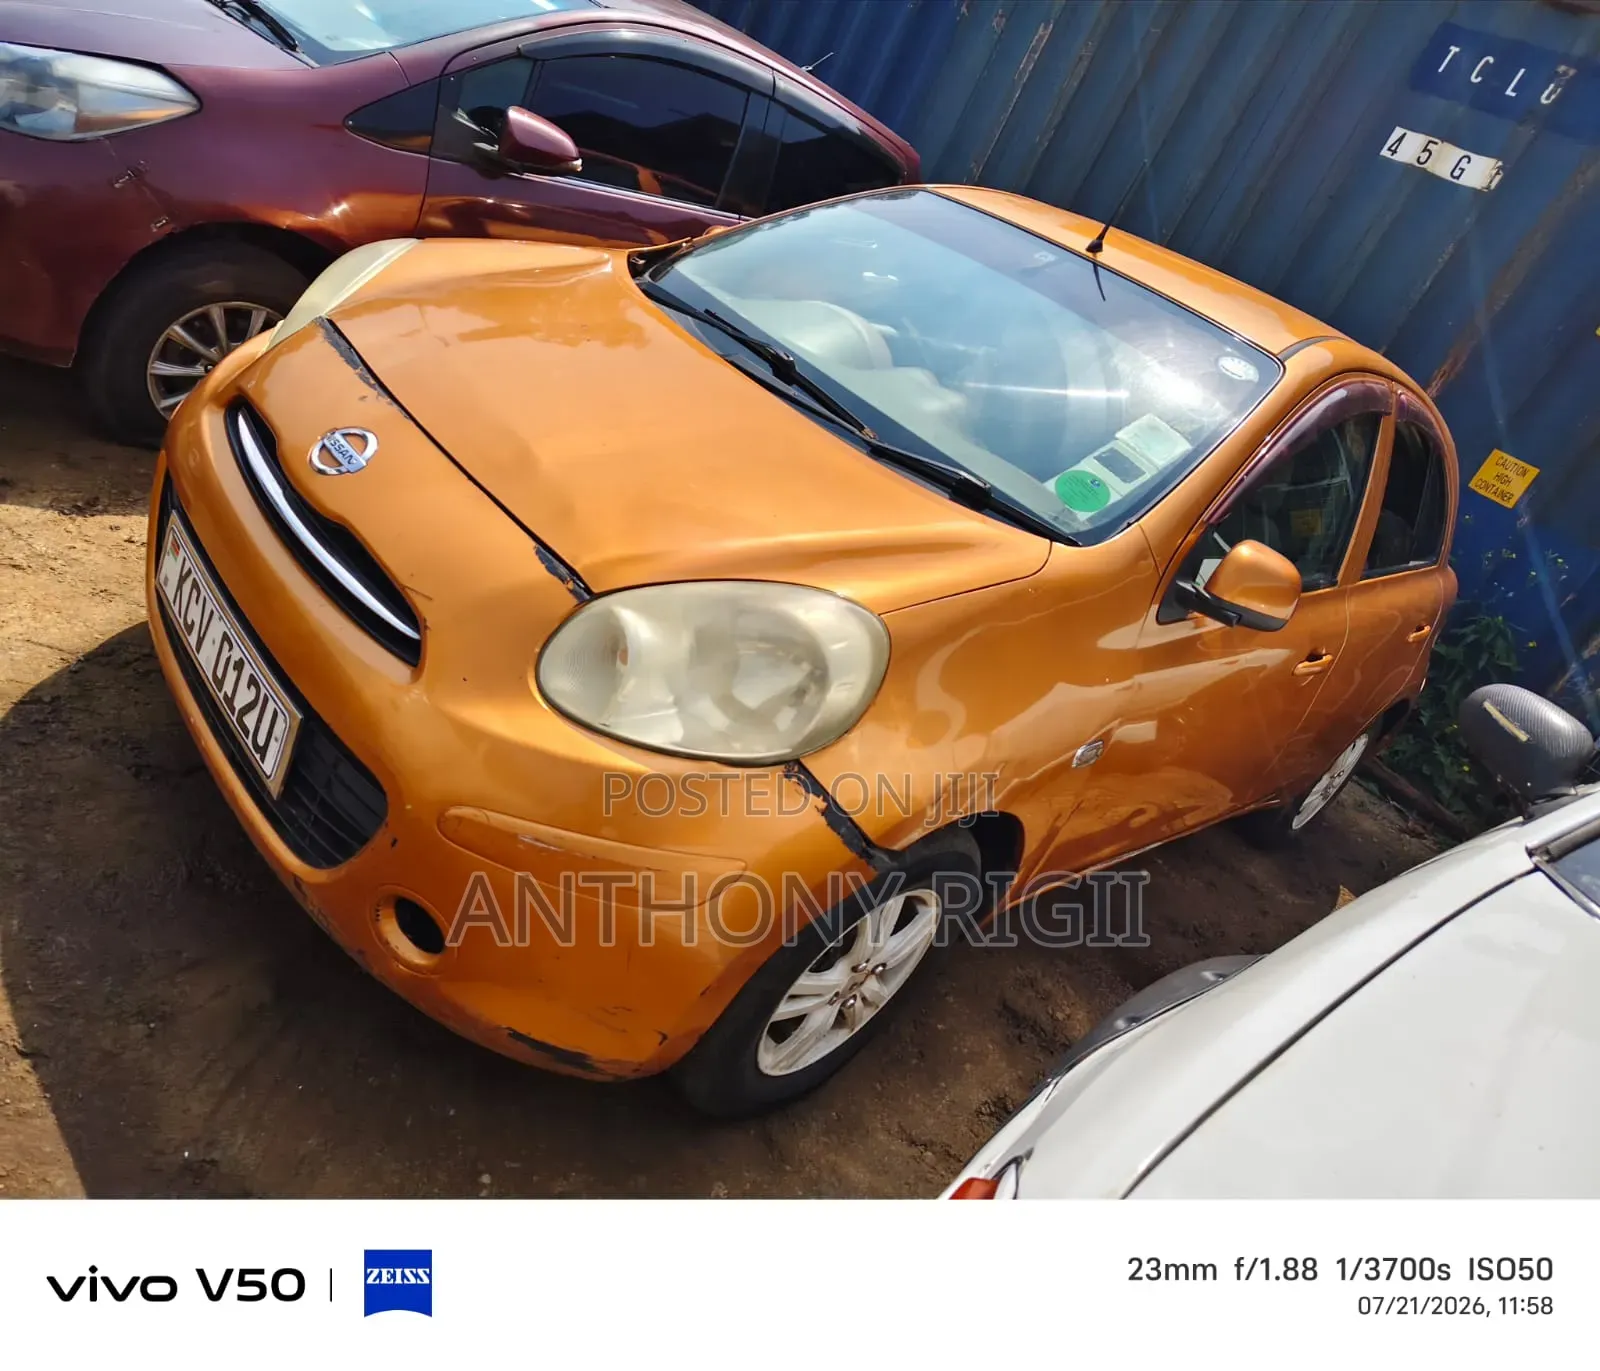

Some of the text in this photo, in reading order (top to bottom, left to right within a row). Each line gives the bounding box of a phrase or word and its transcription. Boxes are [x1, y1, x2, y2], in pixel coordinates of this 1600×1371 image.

[1495, 456, 1529, 478] CAUTION
[1475, 478, 1514, 503] CONTAINER
[1493, 471, 1513, 487] HIGH
[172, 555, 214, 655] KCV
